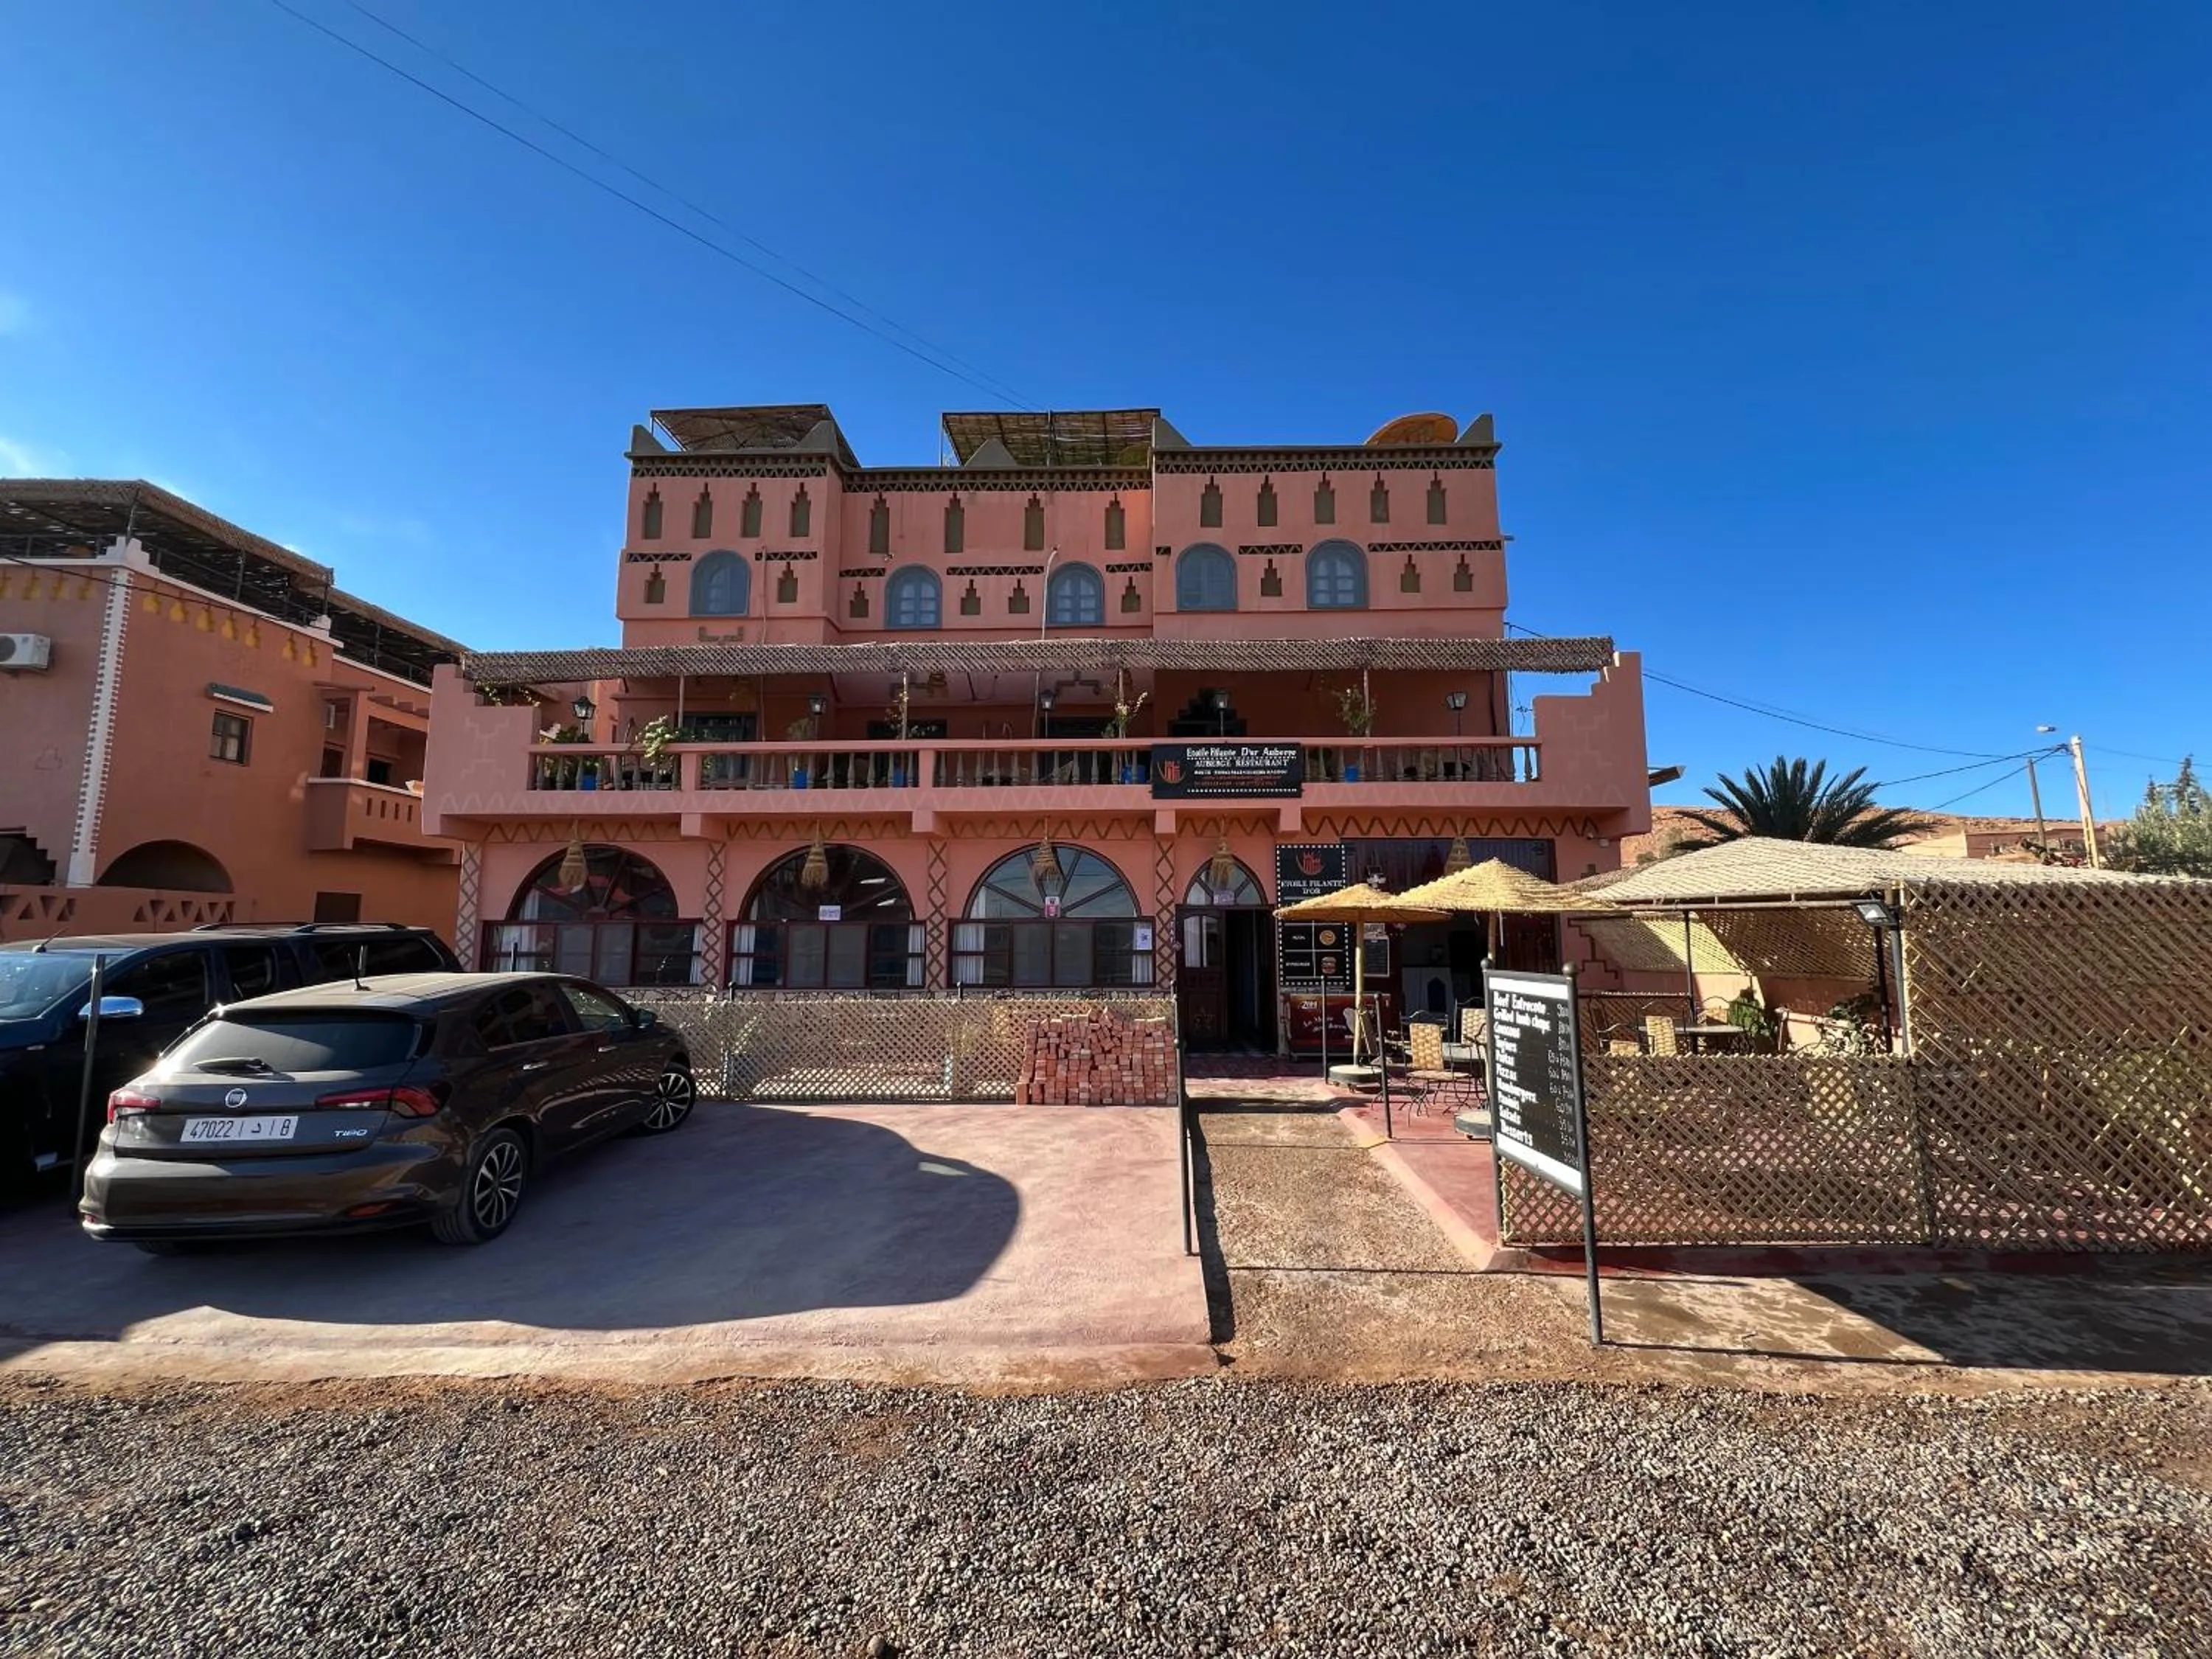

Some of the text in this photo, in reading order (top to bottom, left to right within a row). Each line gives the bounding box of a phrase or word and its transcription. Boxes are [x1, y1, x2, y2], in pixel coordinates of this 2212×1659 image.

[1235, 759, 1288, 767] RESTAURANT
[1494, 1007, 1514, 1023] Grilled
[190, 1120, 234, 1138] 47022
